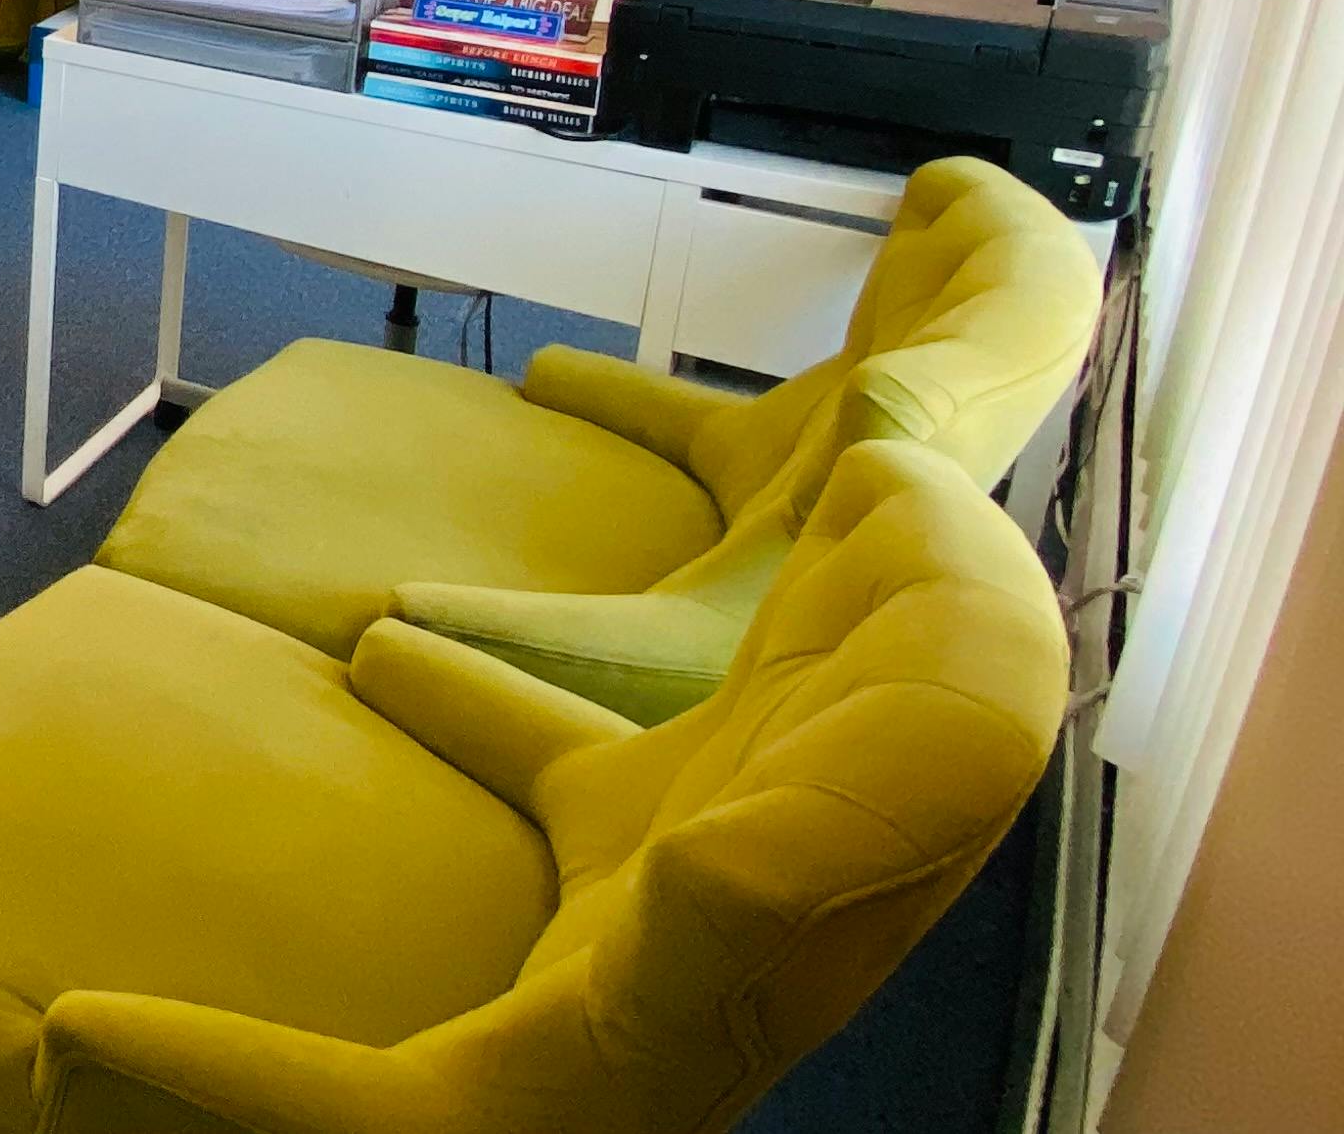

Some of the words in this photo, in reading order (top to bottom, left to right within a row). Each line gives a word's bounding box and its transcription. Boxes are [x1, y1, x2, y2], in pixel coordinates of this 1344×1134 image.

[550, 0, 588, 22] DEAL
[462, 45, 510, 59] BEFORE
[435, 56, 487, 71] SPIRITS
